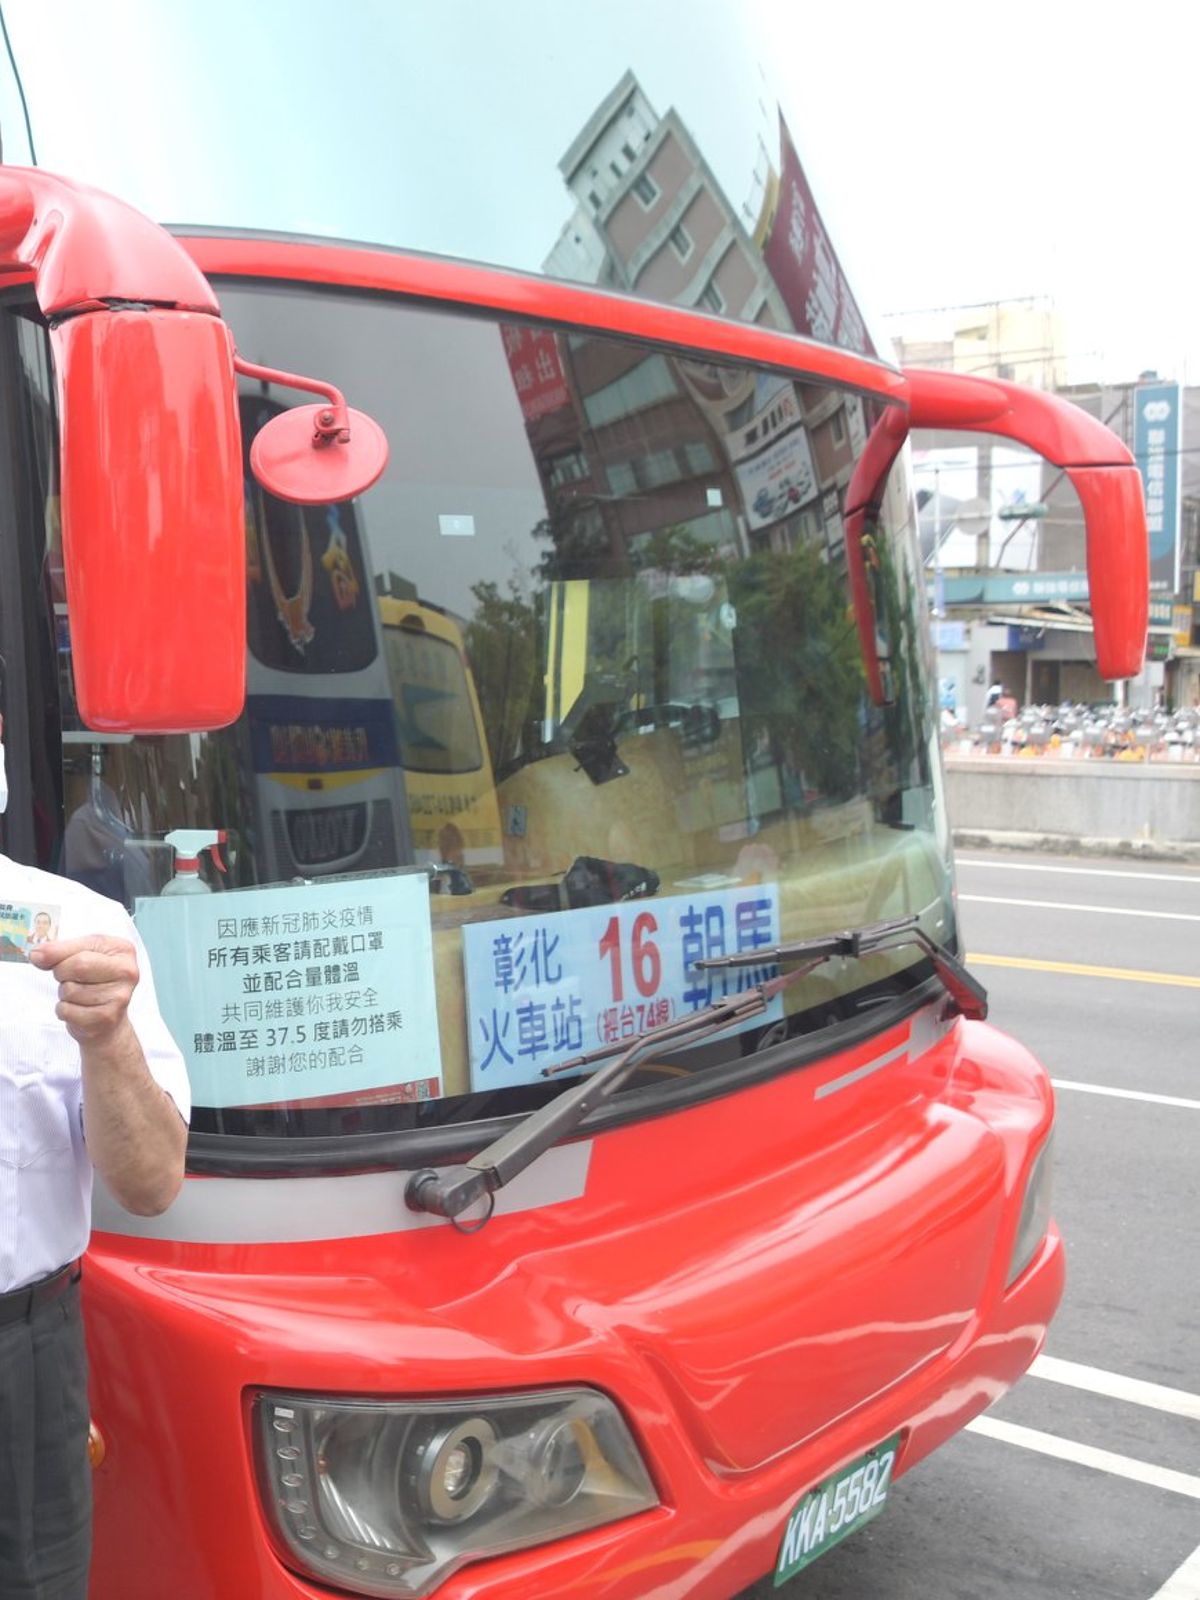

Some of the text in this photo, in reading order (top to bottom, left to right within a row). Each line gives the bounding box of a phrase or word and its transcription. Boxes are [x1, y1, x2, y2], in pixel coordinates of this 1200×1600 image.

[217, 905, 374, 940] 因應新冠肺炎疫情
[207, 930, 385, 969] 所有乘客請配戴口罩
[492, 928, 563, 994] 彰化
[599, 911, 662, 1003] 16
[679, 898, 778, 1011] 朝馬
[242, 961, 360, 994] 並配合量體溫
[221, 987, 379, 1024] 共同維護你我安全
[193, 1009, 403, 1054] 體溫至 37.5 度請勿搭乘
[479, 994, 584, 1071] 火車站
[246, 1044, 364, 1078] 謝謝您的配合
[778, 1450, 895, 1573] KKA-5582
